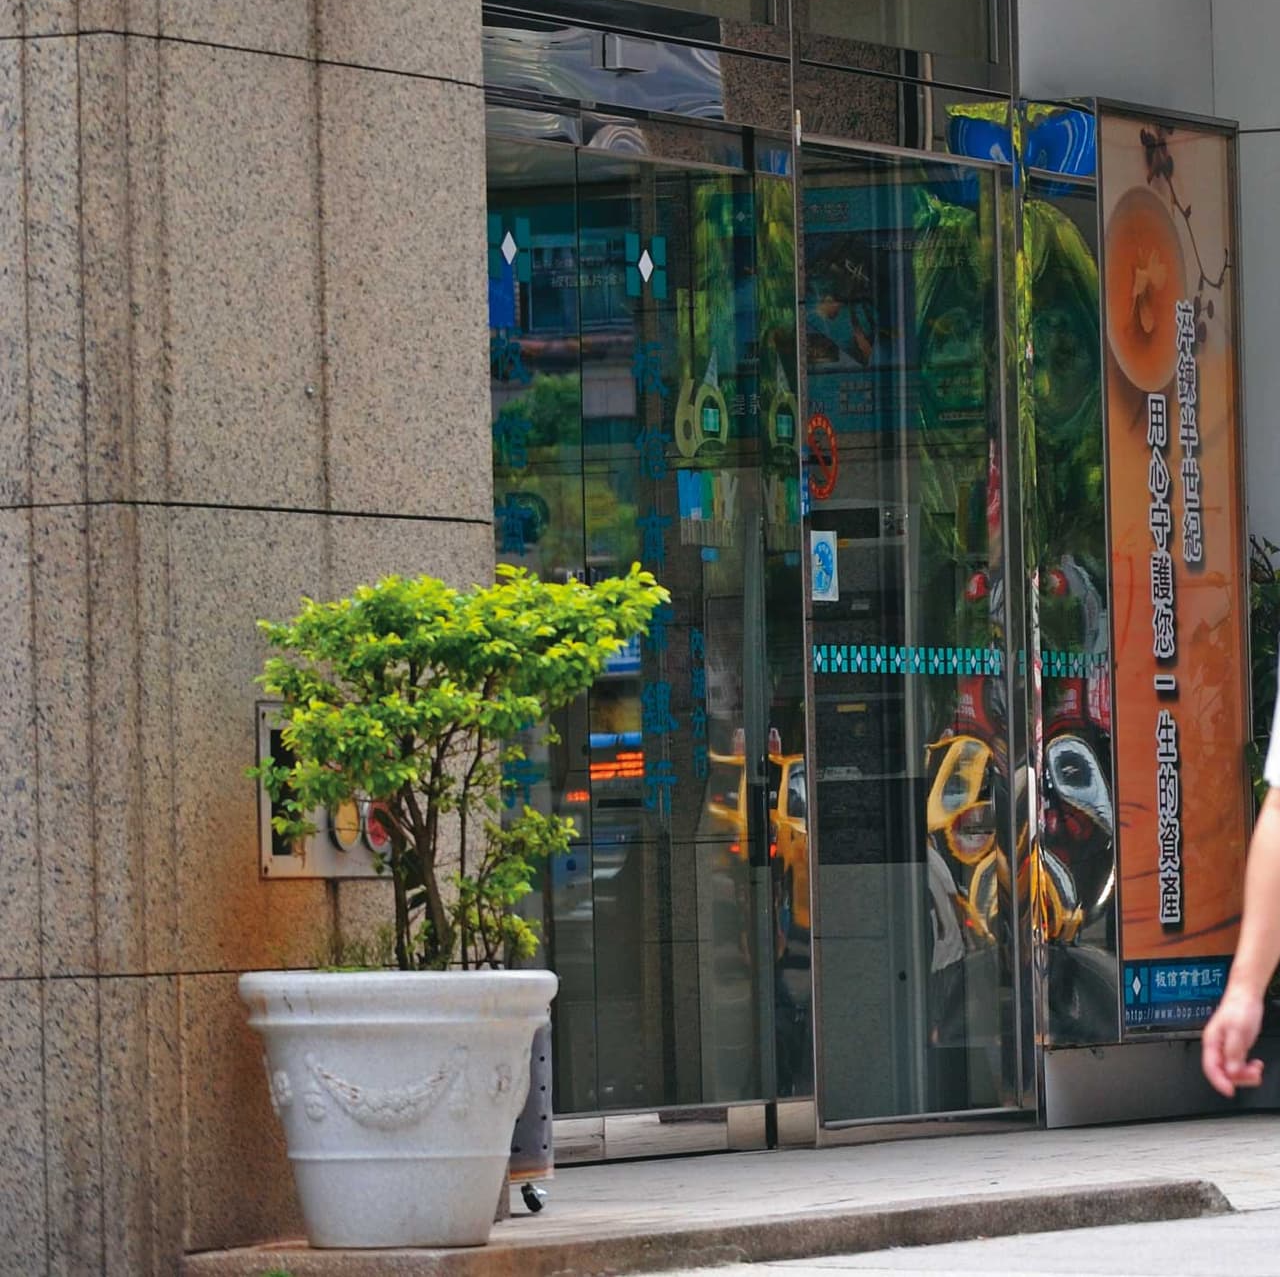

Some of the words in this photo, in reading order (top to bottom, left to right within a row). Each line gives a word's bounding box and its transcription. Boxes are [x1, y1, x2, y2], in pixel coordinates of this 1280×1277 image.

[1146, 393, 1182, 926] 用心守護您一生的資產
